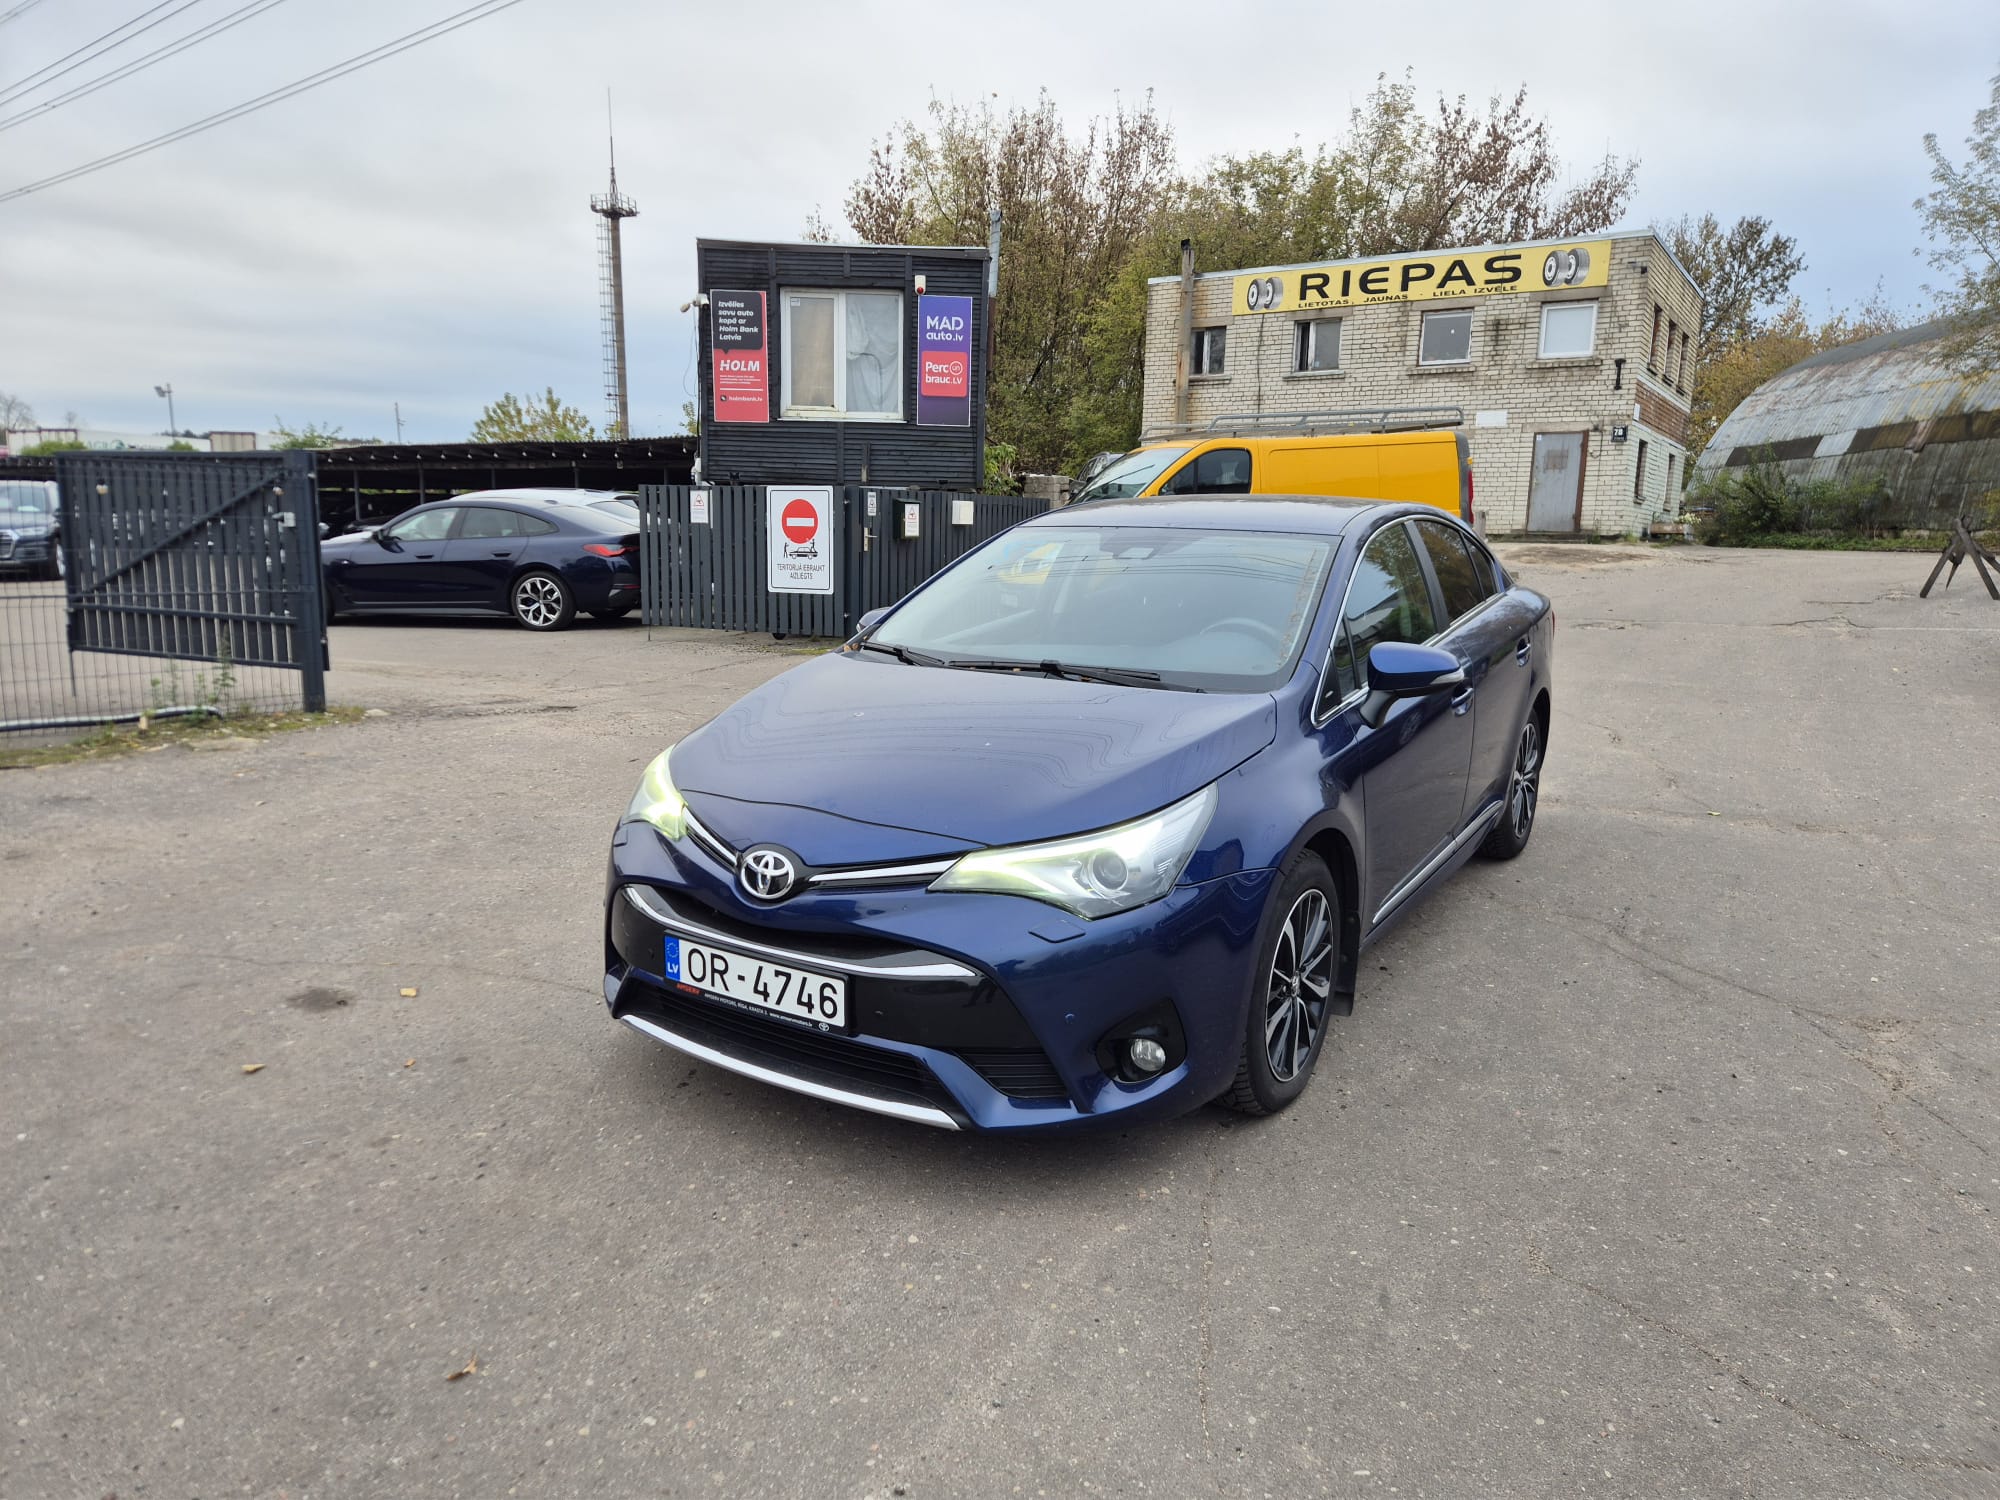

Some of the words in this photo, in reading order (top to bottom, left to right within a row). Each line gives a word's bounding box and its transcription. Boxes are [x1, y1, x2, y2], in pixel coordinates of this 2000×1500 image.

[1299, 254, 1522, 300] RIEPAS
[1363, 293, 1408, 303] JAUNAS
[1432, 288, 1466, 297] LIELA
[739, 325, 759, 333] Bank
[926, 315, 964, 331] MAD
[719, 333, 742, 341] Latvia
[926, 331, 964, 341] auto.lv
[720, 359, 760, 372] HOLM
[925, 361, 949, 373] Perc
[667, 962, 679, 974] LV
